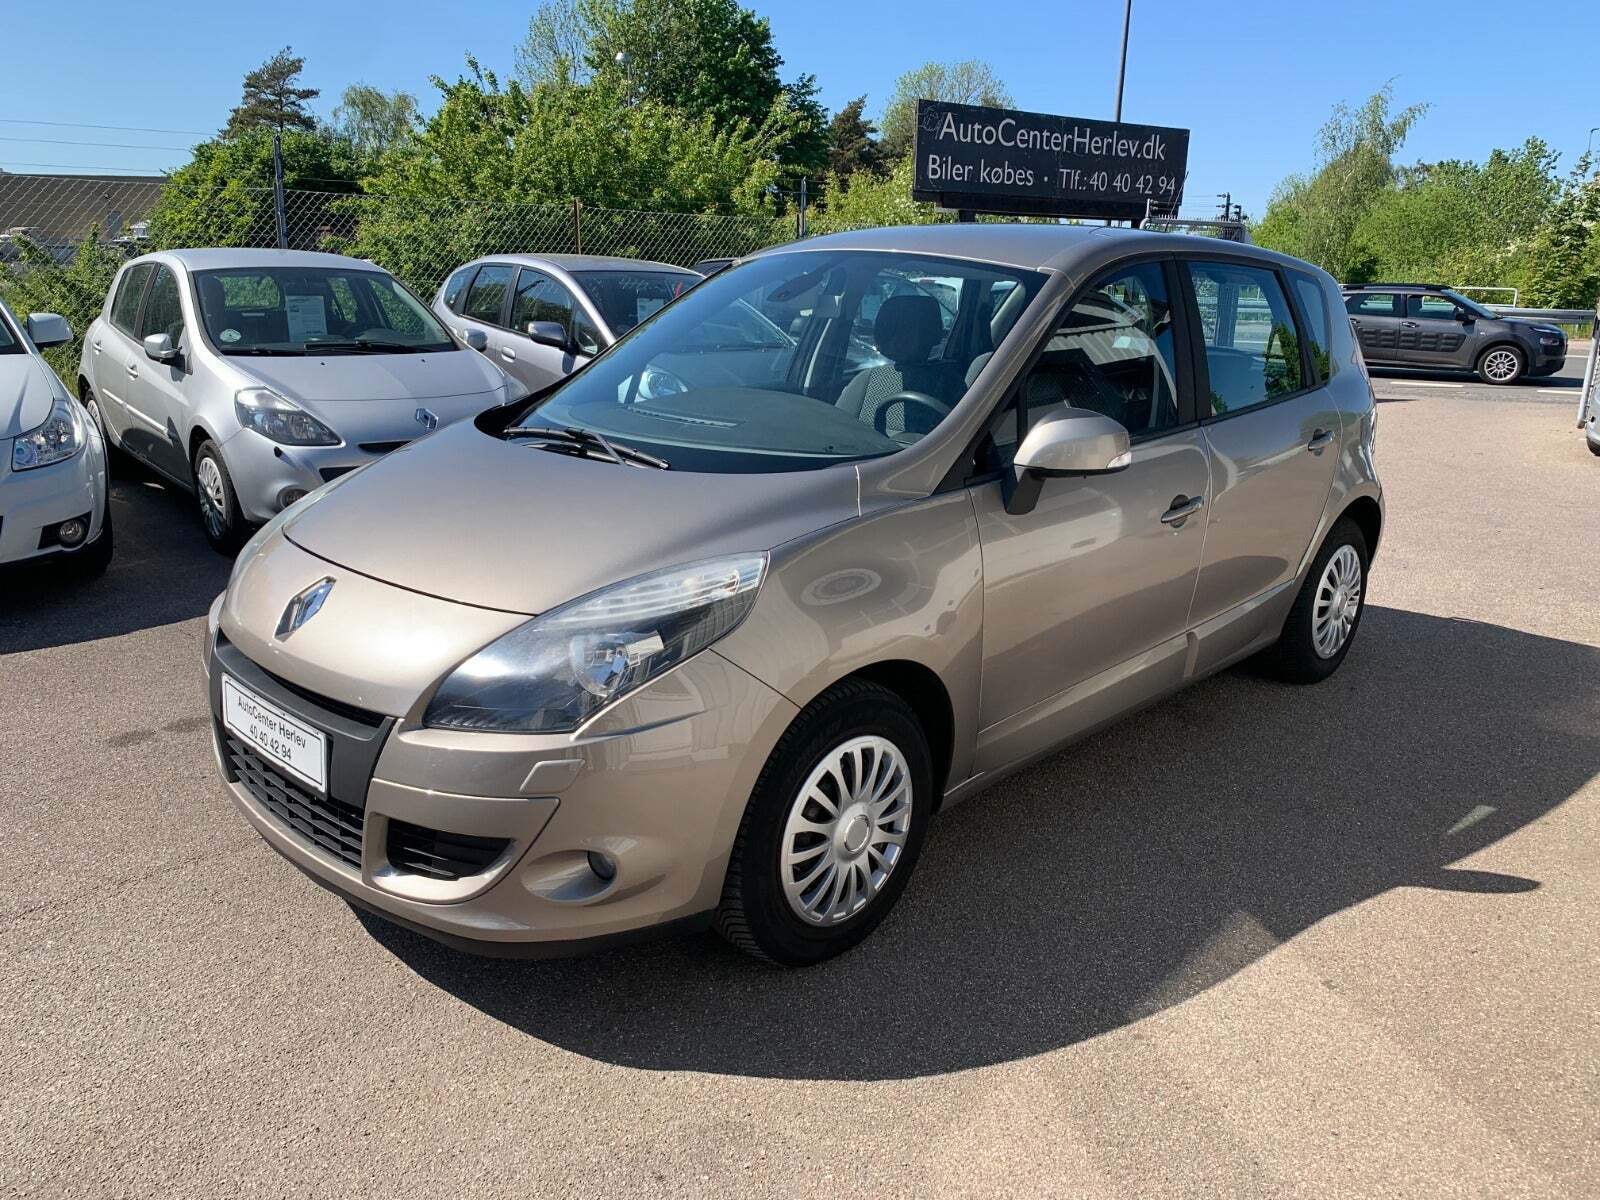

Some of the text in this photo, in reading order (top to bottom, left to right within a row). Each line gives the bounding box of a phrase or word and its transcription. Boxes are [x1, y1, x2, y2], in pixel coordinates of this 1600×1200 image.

[939, 112, 1165, 160] AutoCenterHerlev.dk
[928, 154, 973, 181] Biler
[980, 159, 1034, 186] købes
[1112, 173, 1131, 193] 40
[1136, 175, 1153, 194] 42
[1159, 176, 1176, 194] 94
[238, 696, 306, 748] AutoCenter Herlev
[249, 724, 292, 760] 40 40 42 94
